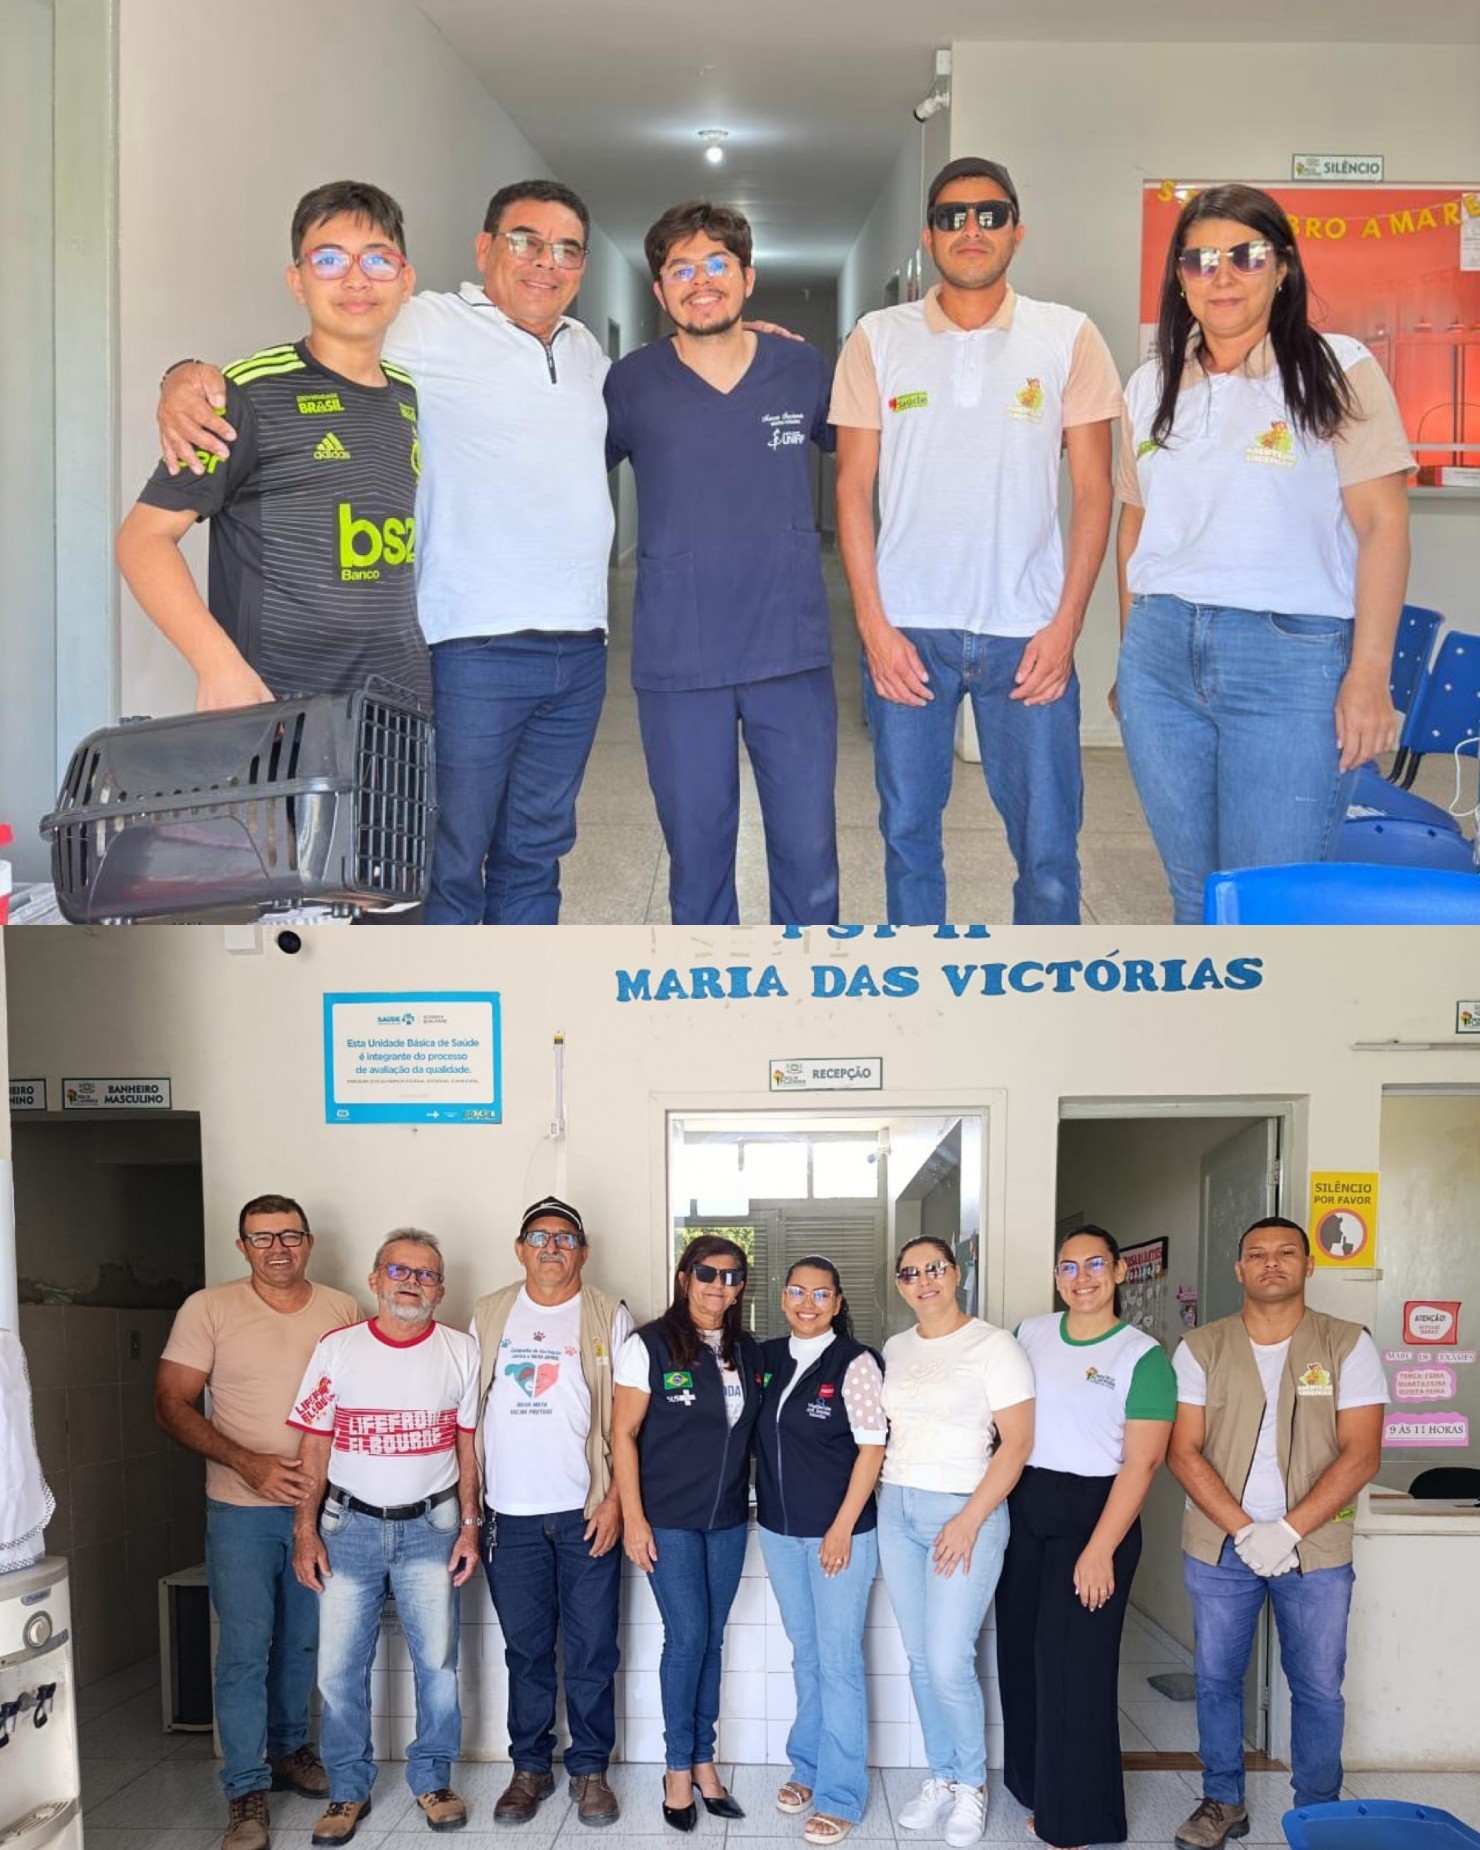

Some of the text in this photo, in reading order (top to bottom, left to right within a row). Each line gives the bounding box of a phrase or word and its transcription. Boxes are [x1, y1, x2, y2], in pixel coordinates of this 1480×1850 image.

[1323, 160, 1380, 175] SILÊNCIO
[297, 399, 345, 414] BRASIL
[341, 569, 380, 581] Banco
[615, 949, 1264, 1002] MARIA DAS VICTÓRIAS
[347, 1038, 479, 1048] Esta Unidade Básica de Saúde
[359, 1051, 468, 1063] é integrante do processo
[356, 1064, 471, 1075] de avaliação da qualidade.
[812, 1065, 872, 1080] RECEPÇÃO
[108, 1085, 159, 1094] BANHEIRO
[103, 1095, 164, 1104] MASCULINO
[1315, 1181, 1372, 1193] SILÊNCIO
[1313, 1195, 1372, 1205] POR FAVOR
[1414, 1314, 1446, 1323] ATENÇÃO!
[1389, 1426, 1396, 1434] 9
[1415, 1425, 1426, 1434] 11
[1428, 1424, 1464, 1435] HORAS
